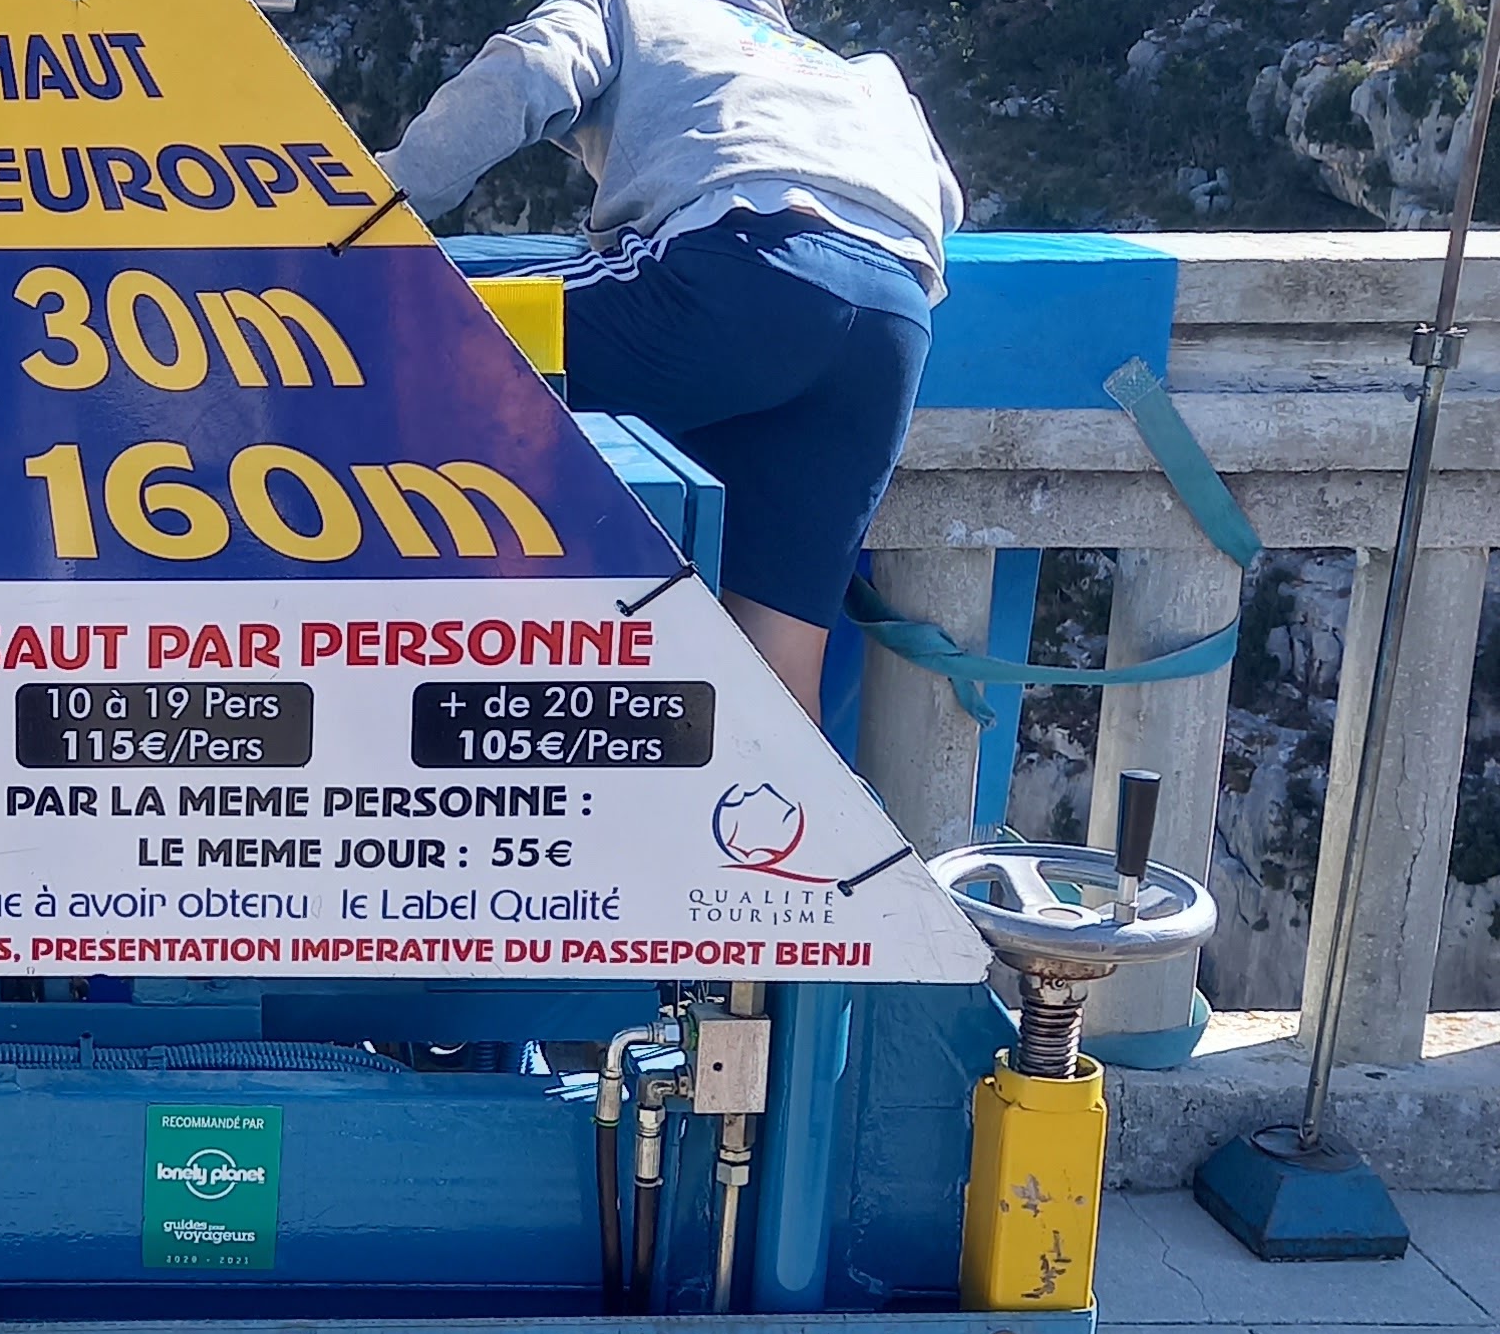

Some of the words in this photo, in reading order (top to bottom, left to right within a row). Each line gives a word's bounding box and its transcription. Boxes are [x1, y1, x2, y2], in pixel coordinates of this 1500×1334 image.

[20, 266, 365, 391] 30m
[24, 439, 564, 563] 160m
[148, 624, 281, 670] PAR
[300, 619, 654, 667] PERSONNE
[46, 688, 93, 720] 10
[105, 687, 127, 720] à
[145, 687, 190, 720] 19
[204, 687, 280, 719] Pers
[440, 691, 467, 718] +
[483, 685, 531, 720] de
[543, 686, 594, 719] 20
[608, 686, 685, 719] Pers
[60, 728, 263, 765] 115€/Pers
[458, 728, 662, 764] 105€/Pers
[7, 786, 98, 817] PAR
[111, 785, 166, 817] LA
[179, 785, 310, 817] MEME
[323, 784, 568, 818] PERSONNE
[138, 837, 184, 867] LE
[199, 838, 322, 868] MEME
[335, 838, 446, 869] JOUR
[491, 838, 573, 868] 55€
[35, 884, 57, 918] à
[69, 887, 167, 919] avoir
[178, 887, 308, 920] obtenu
[342, 888, 368, 919] le
[381, 888, 477, 920] Label
[490, 885, 621, 923] Qualité
[689, 908, 835, 926] TOURISME
[31, 937, 281, 963] PRESENTATION
[291, 937, 494, 963] IMPERATIVE
[505, 939, 551, 964] DU
[561, 939, 766, 966] PASSEPORT
[775, 941, 872, 968] BENJI
[161, 1115, 241, 1130] RECOMMANDÉ
[243, 1118, 264, 1130] PAR
[157, 1163, 207, 1186] lonely
[210, 1164, 265, 1186] planet
[163, 1219, 207, 1232] guides
[174, 1229, 255, 1245] voyageurs
